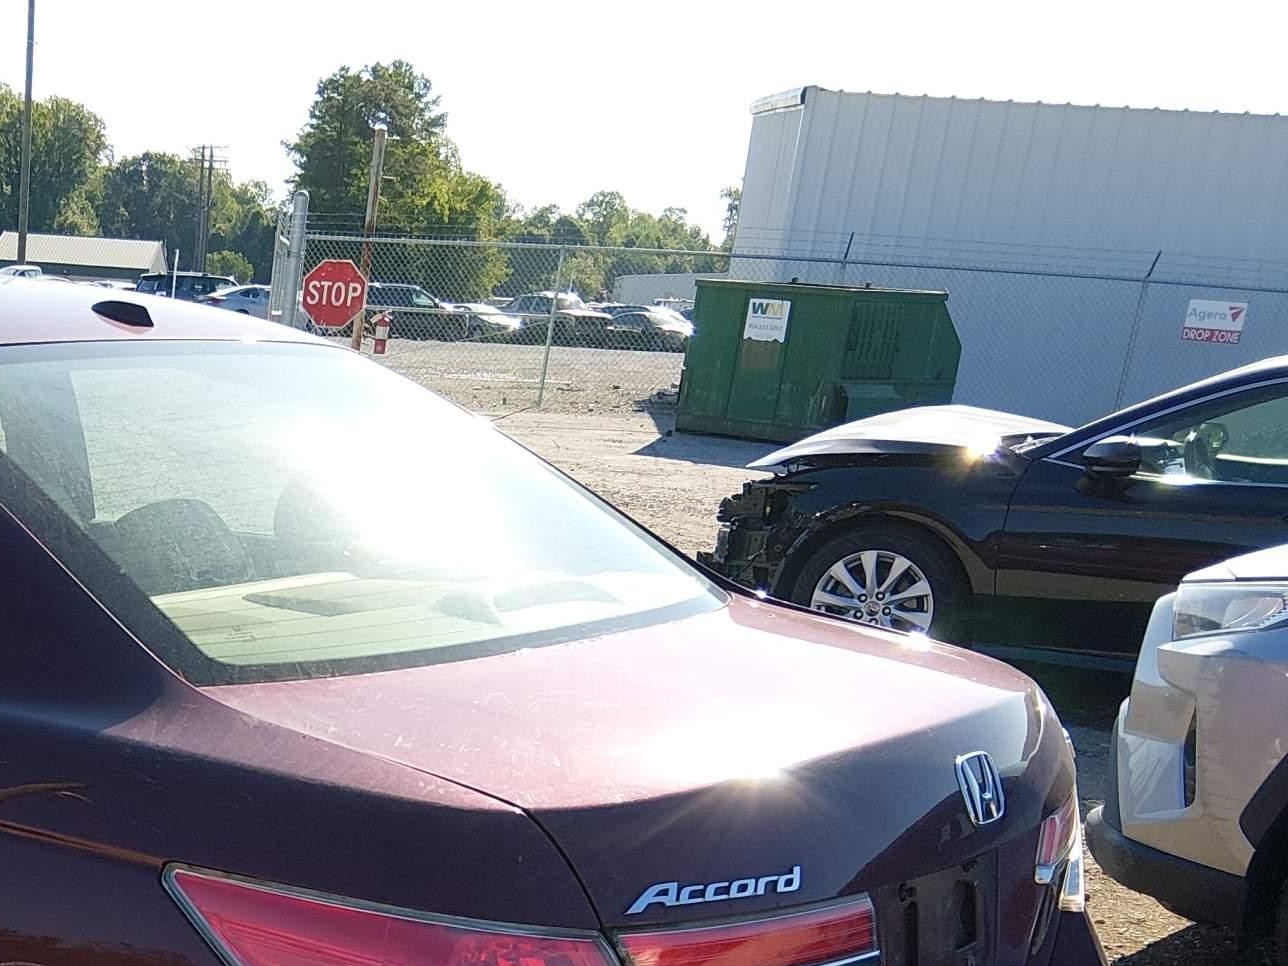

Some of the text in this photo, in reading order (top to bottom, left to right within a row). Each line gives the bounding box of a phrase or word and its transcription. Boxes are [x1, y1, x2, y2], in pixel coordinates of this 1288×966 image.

[306, 280, 362, 307] STOP
[752, 302, 785, 316] WM
[1187, 307, 1227, 321] Agero
[1182, 328, 1241, 344] DROP ZONE
[623, 865, 802, 915] Accord
